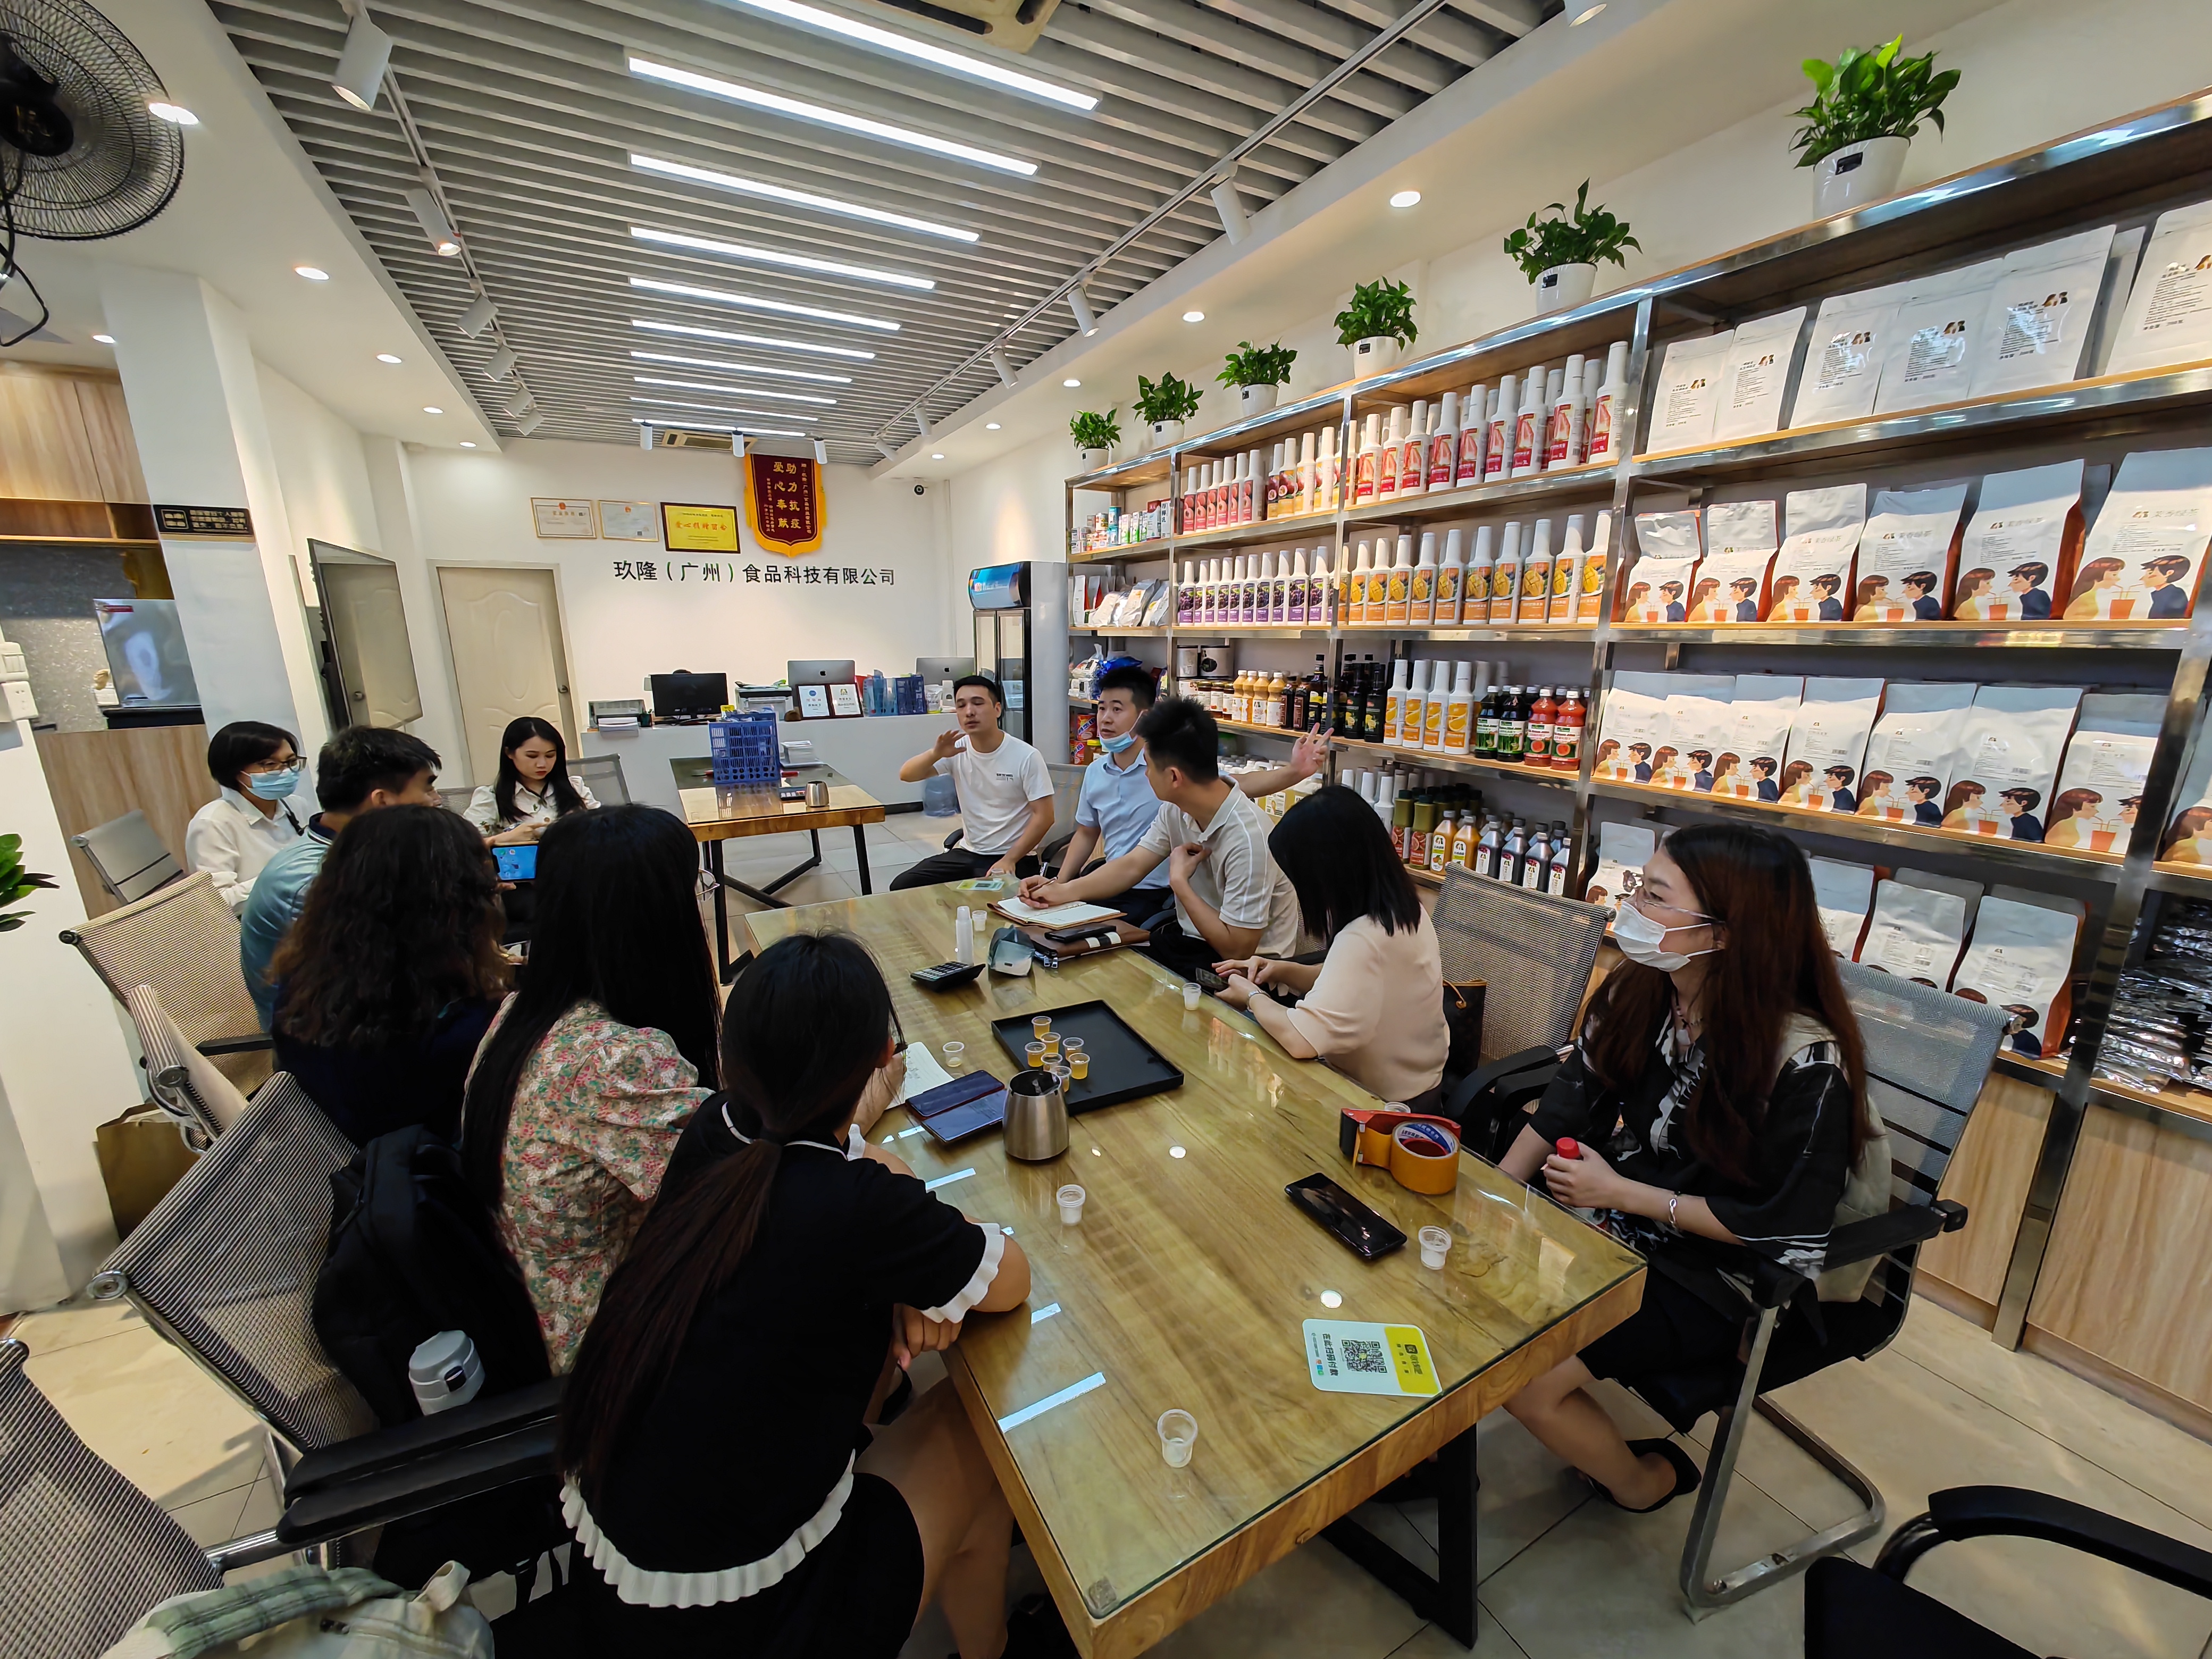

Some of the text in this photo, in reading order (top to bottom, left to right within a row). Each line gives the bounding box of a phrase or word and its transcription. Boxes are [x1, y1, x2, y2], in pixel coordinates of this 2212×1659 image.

[773, 462, 789, 529] 爱心奉献
[785, 463, 801, 529] 助力抗疫
[613, 560, 895, 585] 玖隆（广州）食品科技有限公司
[1322, 1333, 1339, 1376] 在此扫码付款
